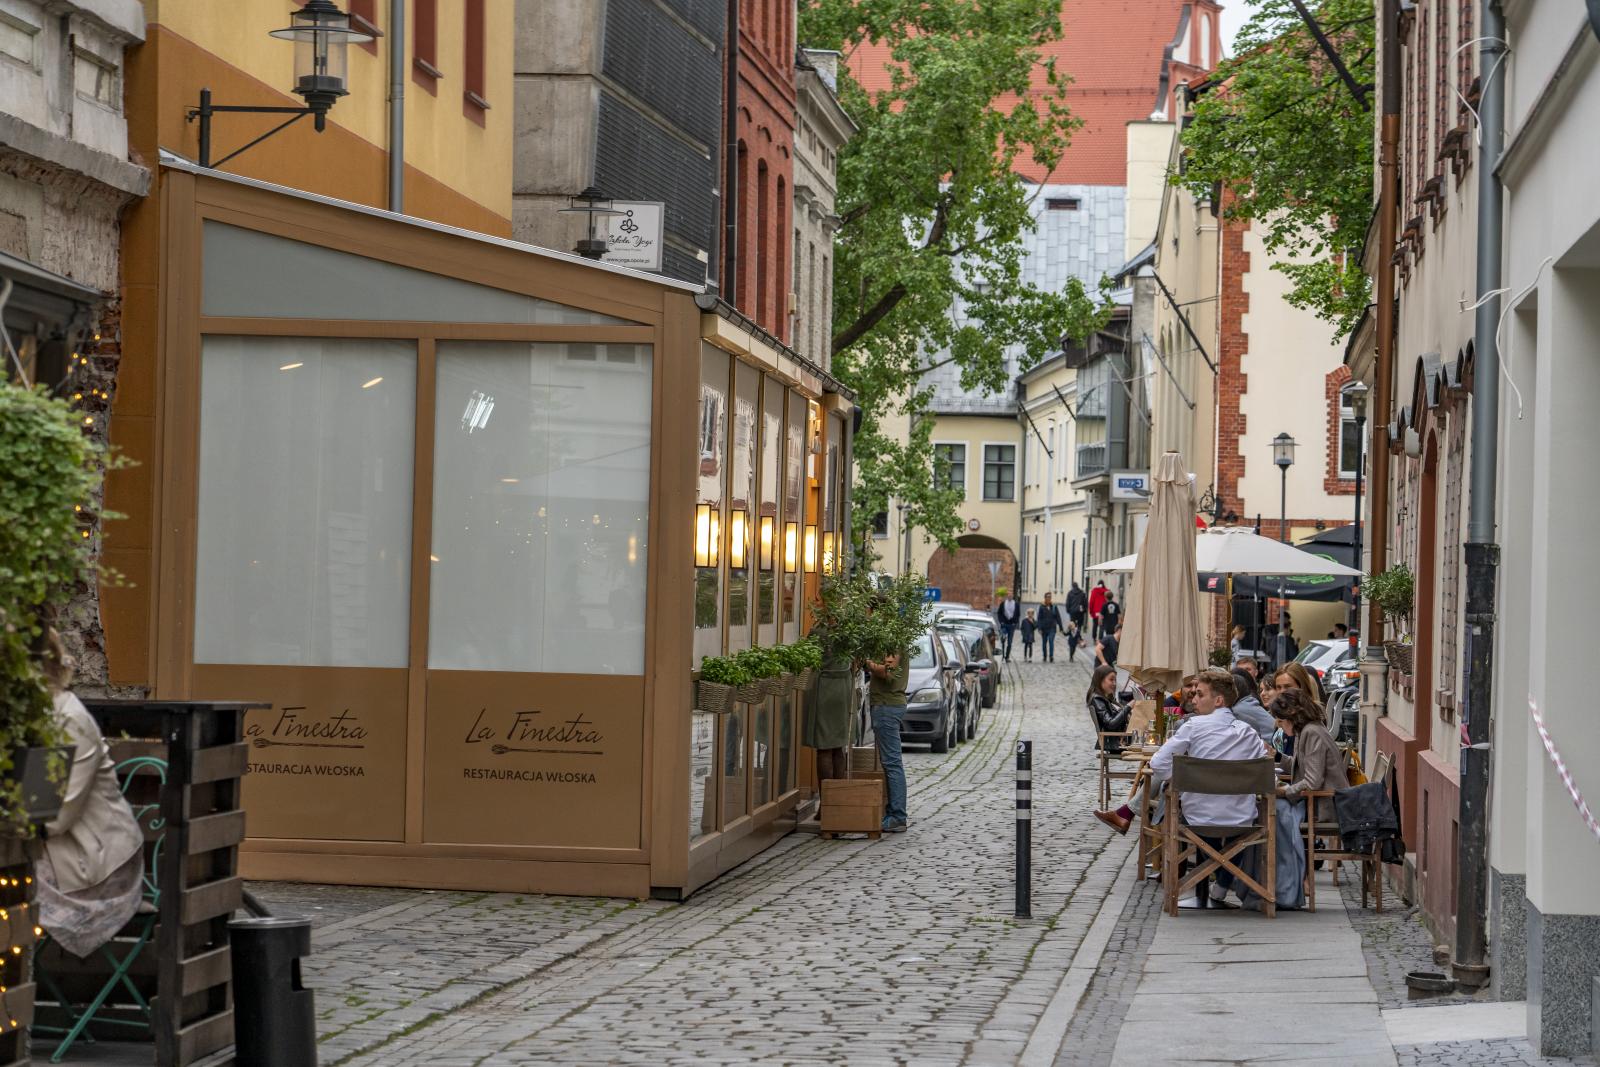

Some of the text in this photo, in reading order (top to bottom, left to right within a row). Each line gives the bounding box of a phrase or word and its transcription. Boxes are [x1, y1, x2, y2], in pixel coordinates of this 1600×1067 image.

[272, 706, 368, 740] Finestra
[465, 708, 604, 744] La Finestra
[314, 764, 365, 777] WŁOSKA
[463, 768, 597, 784] RESTAURACJA WŁOSKA
